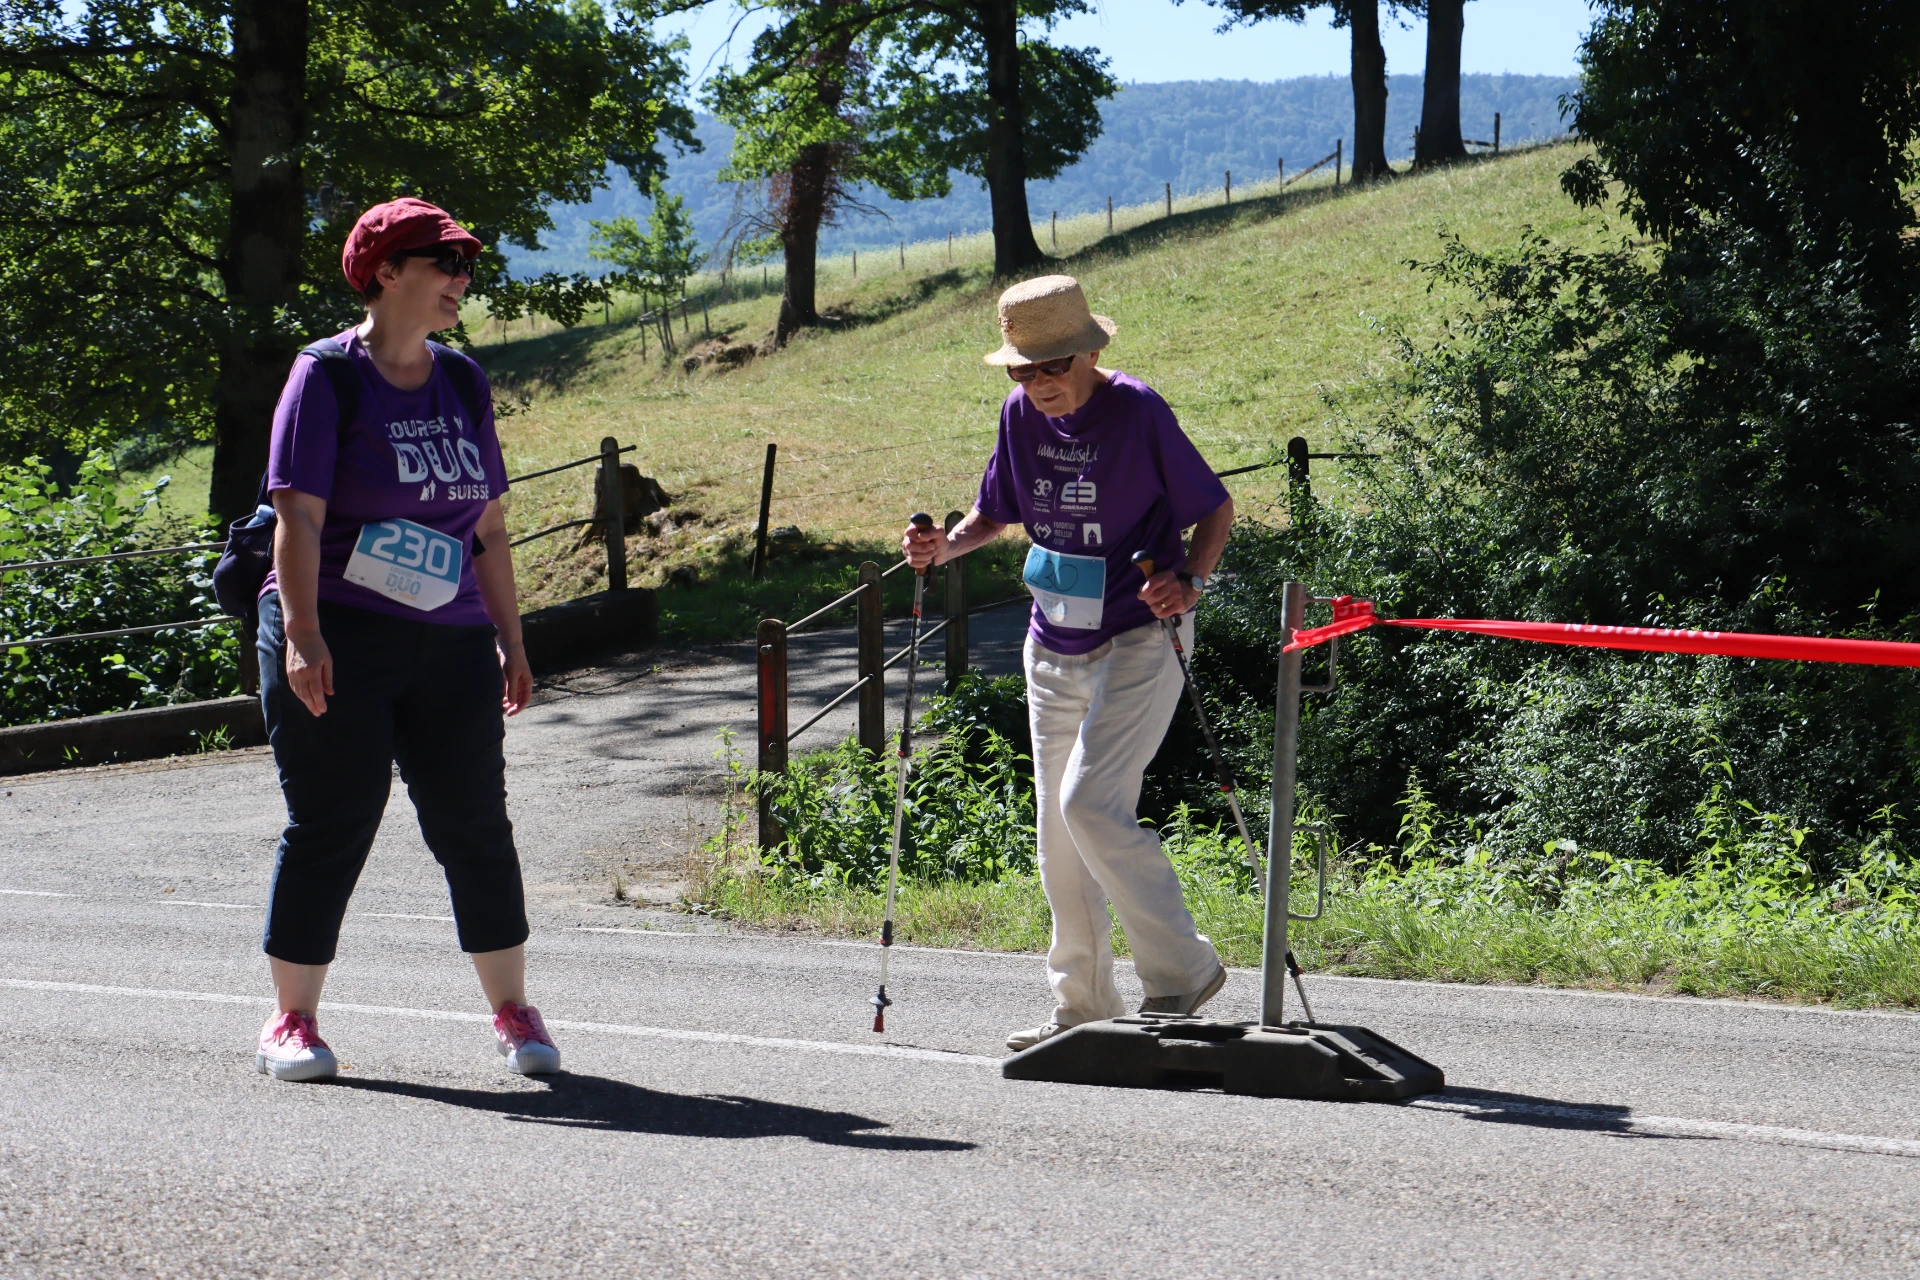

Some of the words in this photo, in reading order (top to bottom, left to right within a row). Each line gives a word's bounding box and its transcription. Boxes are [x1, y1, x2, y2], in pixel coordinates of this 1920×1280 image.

[385, 415, 449, 439] OURSE
[391, 438, 485, 483] DUO
[448, 484, 489, 501] SUISSE
[370, 522, 452, 577] 230
[385, 572, 422, 596] DUO
[1028, 553, 1079, 592] 230
